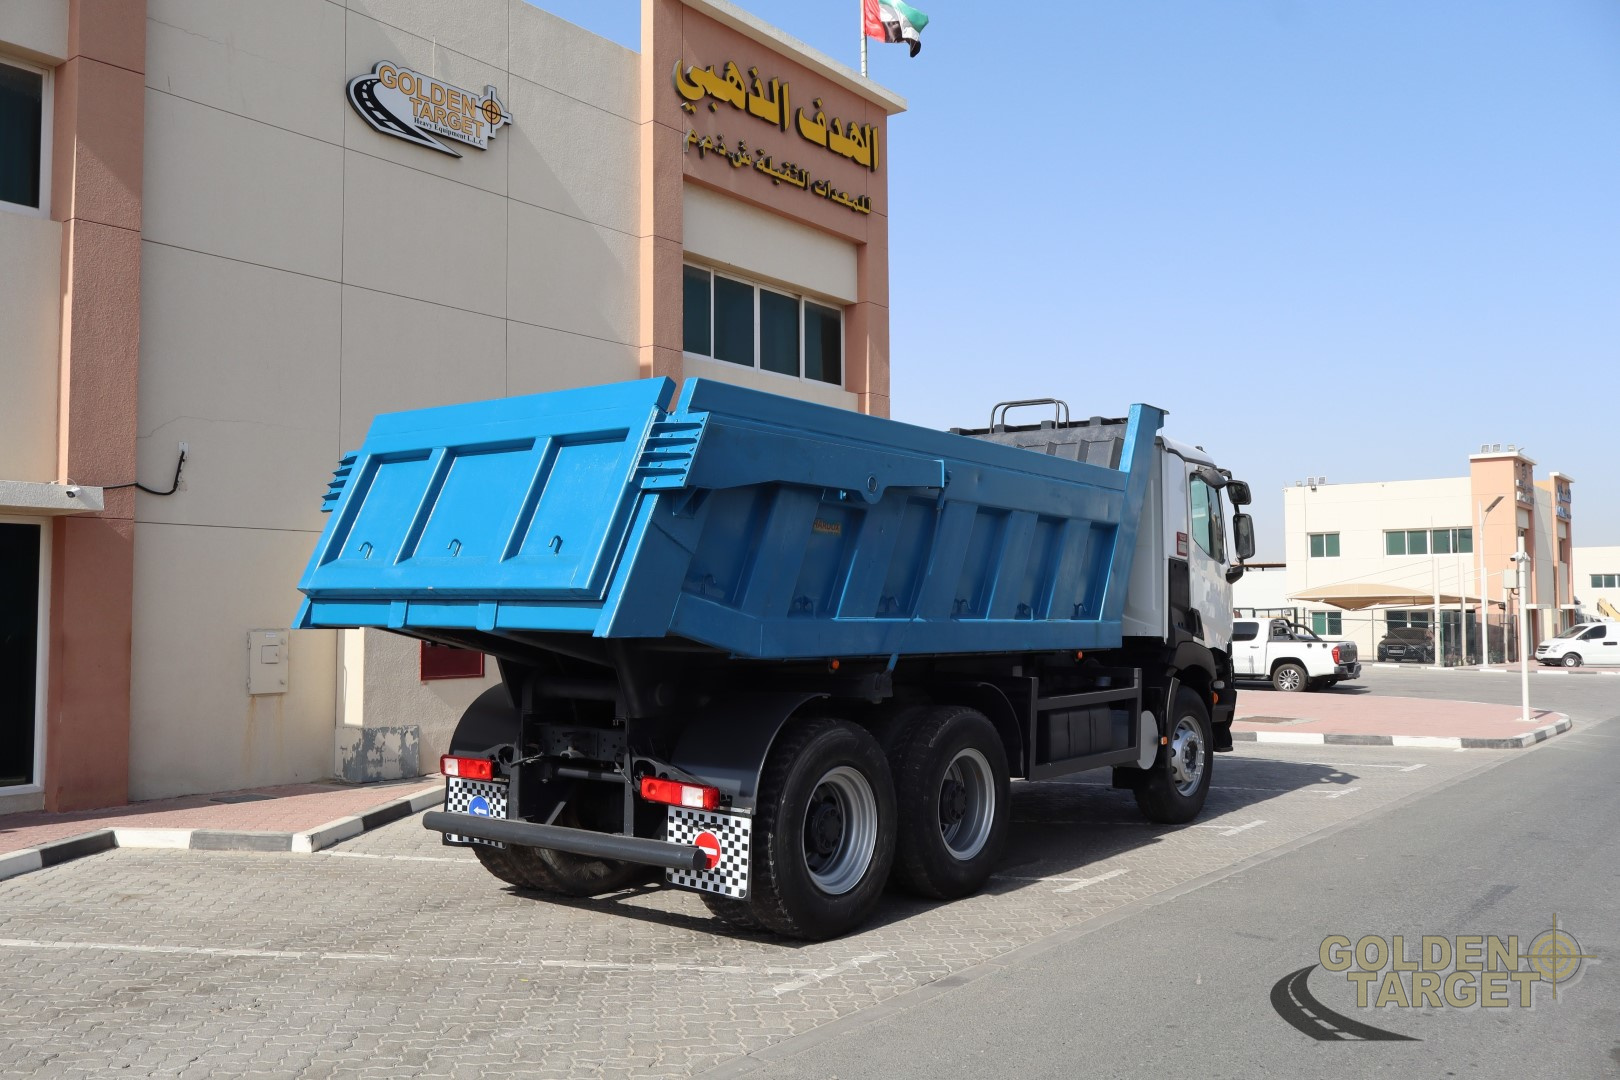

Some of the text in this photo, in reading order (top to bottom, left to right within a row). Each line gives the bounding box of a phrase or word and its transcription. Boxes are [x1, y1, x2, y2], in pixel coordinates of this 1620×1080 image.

[379, 65, 476, 118] GOLDEN
[409, 97, 484, 138] TARGET
[414, 117, 432, 130] Heavy
[434, 123, 466, 140] Equipment
[672, 58, 880, 172] الهدف الذهبي
[752, 149, 810, 191] الثقيلة
[811, 180, 872, 214] للمعدات
